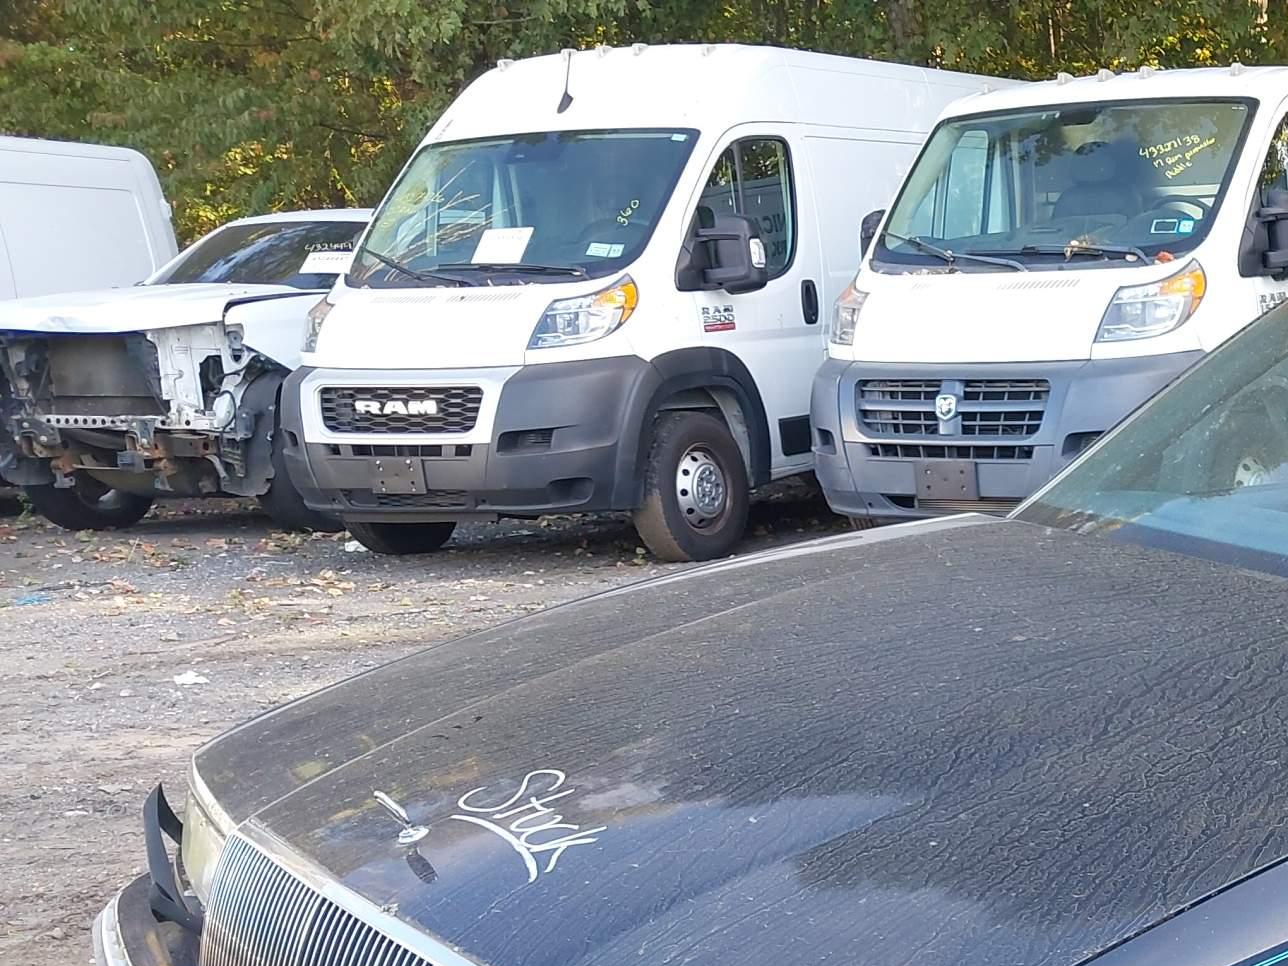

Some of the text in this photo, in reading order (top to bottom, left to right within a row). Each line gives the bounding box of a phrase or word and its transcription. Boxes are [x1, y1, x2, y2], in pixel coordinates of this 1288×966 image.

[702, 304, 734, 315] RAM
[354, 400, 438, 415] RAM
[457, 769, 608, 873] Stuck
